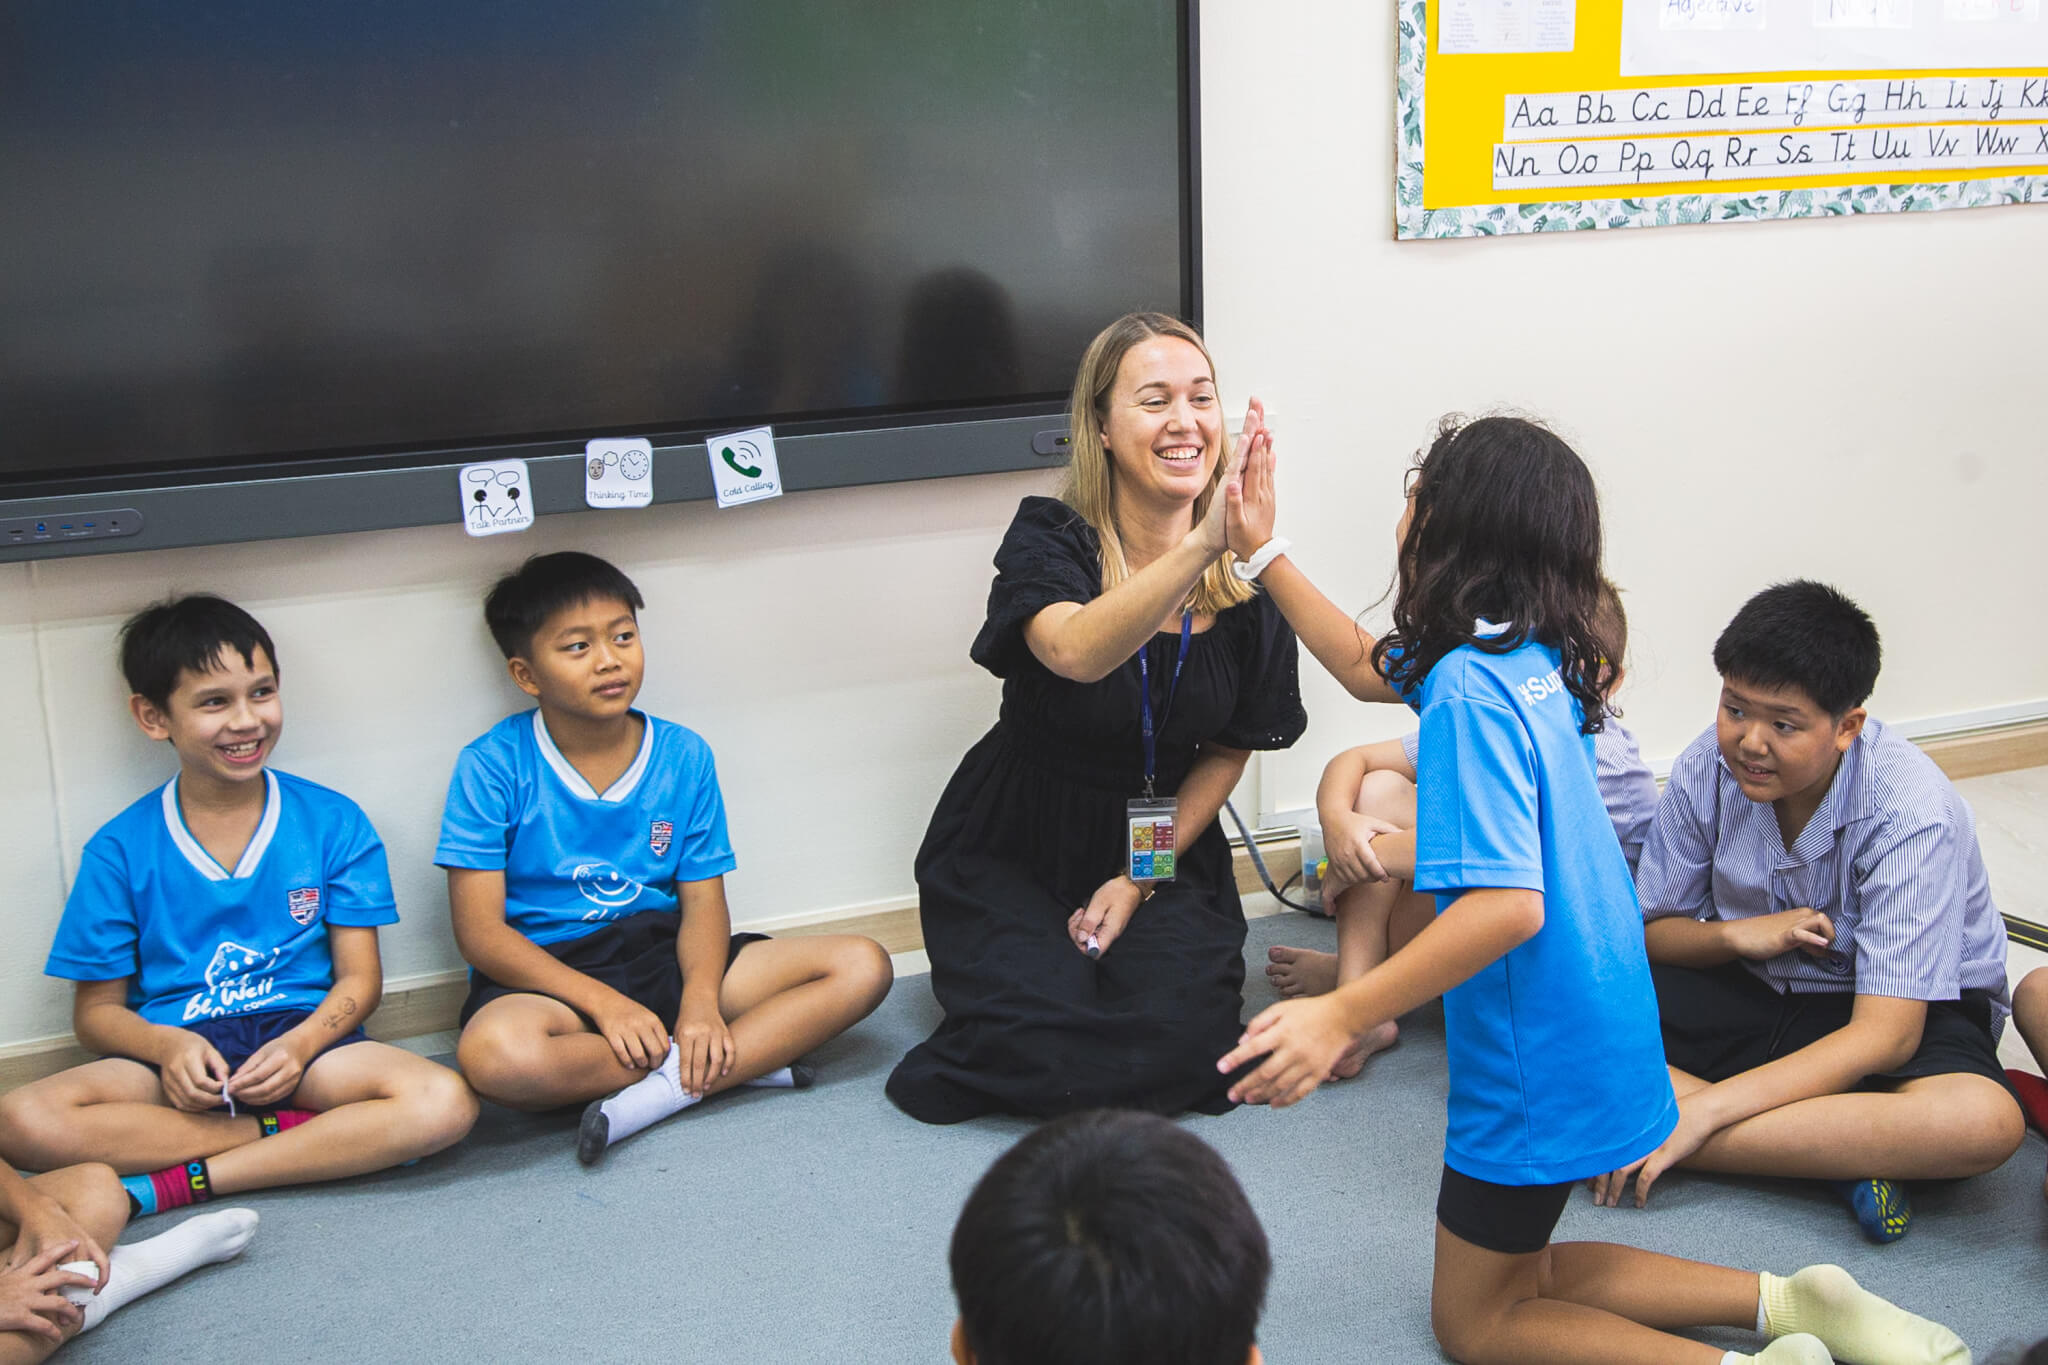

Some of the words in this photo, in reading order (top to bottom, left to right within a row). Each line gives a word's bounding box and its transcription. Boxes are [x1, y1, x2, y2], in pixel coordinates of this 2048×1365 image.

[1511, 97, 1559, 128] Aa
[1576, 93, 1616, 125] Bb
[1632, 92, 1670, 121] Cc
[1686, 88, 1726, 119] Dd
[1736, 86, 1771, 117] Ee
[1785, 83, 1813, 126] Ff
[1827, 83, 1866, 124] Gg
[1884, 80, 1927, 111] Hh
[1945, 80, 1969, 109] Ii
[1981, 79, 2003, 120] Jj
[1495, 146, 1541, 178] Nn
[1558, 144, 1598, 174] Oo
[1619, 142, 1655, 182] Pp
[1671, 139, 1714, 179] Qq
[1725, 137, 1758, 167] Rr
[1776, 135, 1813, 164] Ss
[1830, 132, 1857, 162] Tt
[1872, 130, 1912, 159] Uu
[1928, 128, 1960, 157] Vv
[1976, 127, 2019, 156] Ww
[589, 490, 625, 501] Thinking
[628, 490, 649, 498] Time
[723, 486, 743, 497] Cold
[744, 481, 774, 493] Calling
[471, 520, 489, 529] Talk
[493, 516, 529, 527] Partners
[221, 976, 274, 1006] Well
